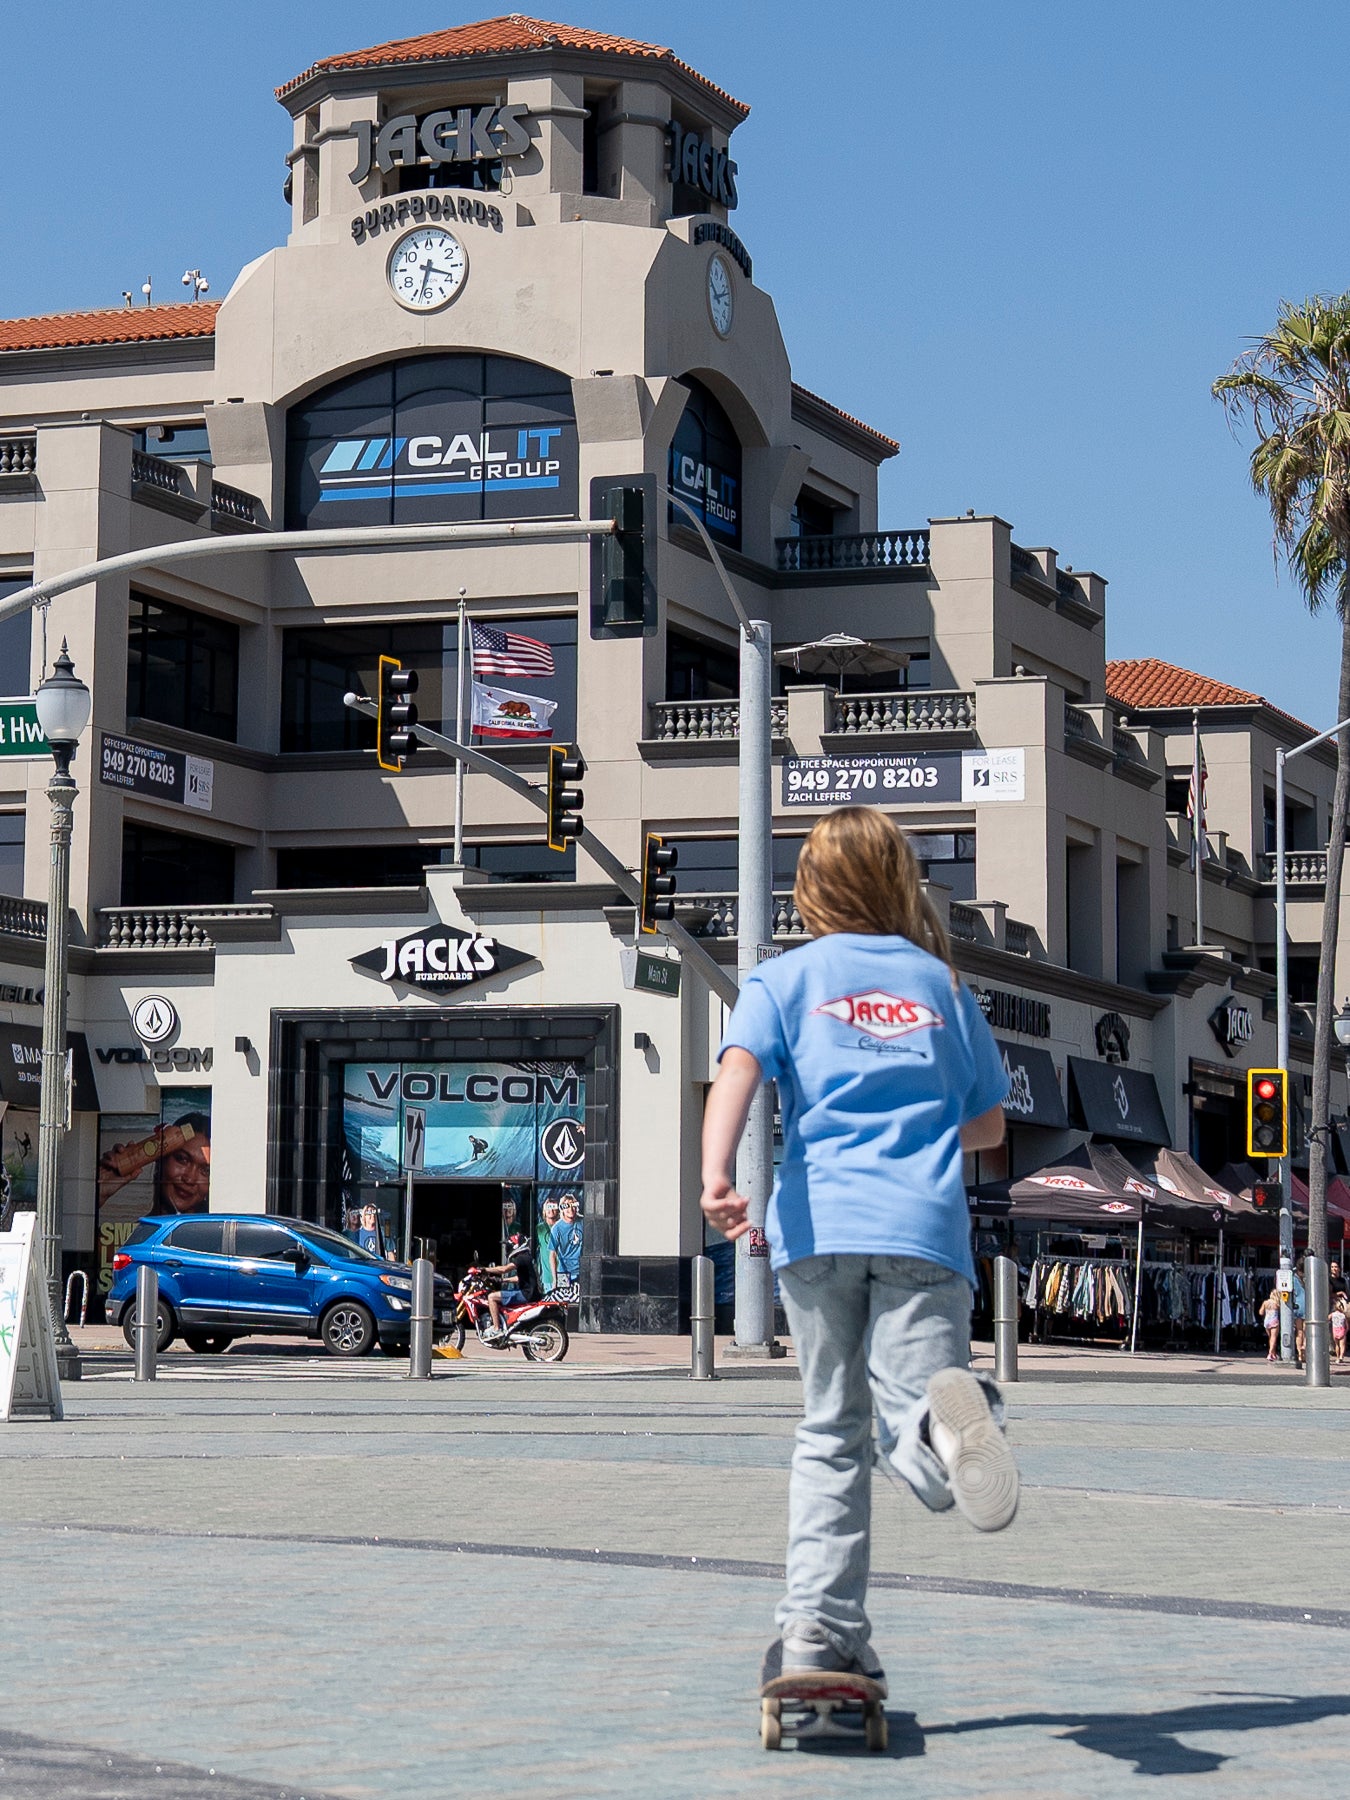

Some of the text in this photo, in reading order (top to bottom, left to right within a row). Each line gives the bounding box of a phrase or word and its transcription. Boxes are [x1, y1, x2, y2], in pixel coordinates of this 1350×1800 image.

[351, 194, 503, 238] SURFBOARDS
[404, 251, 417, 263] 10
[444, 248, 454, 260] 2
[404, 276, 414, 288] 8
[423, 287, 433, 299] 6
[408, 428, 561, 467] CAL IT
[470, 460, 560, 480] GROUP
[681, 456, 718, 498] CAL
[11, 716, 44, 743] Hw
[104, 737, 120, 749] OFFICE
[120, 742, 135, 754] SPACE
[104, 749, 124, 772] 949
[127, 755, 147, 778] 270
[149, 761, 175, 785] 8203
[788, 757, 918, 769] OFFICE SPACE OPPORTUNITY
[788, 767, 939, 790] 949 270 8203
[993, 771, 1018, 783] SRS
[788, 792, 852, 802] ZACH LEFFERS
[415, 972, 473, 981] SURFBOARDS
[648, 964, 668, 985] Main St
[95, 1047, 214, 1065] VOLCOM
[366, 1070, 580, 1107] VOLCOM
